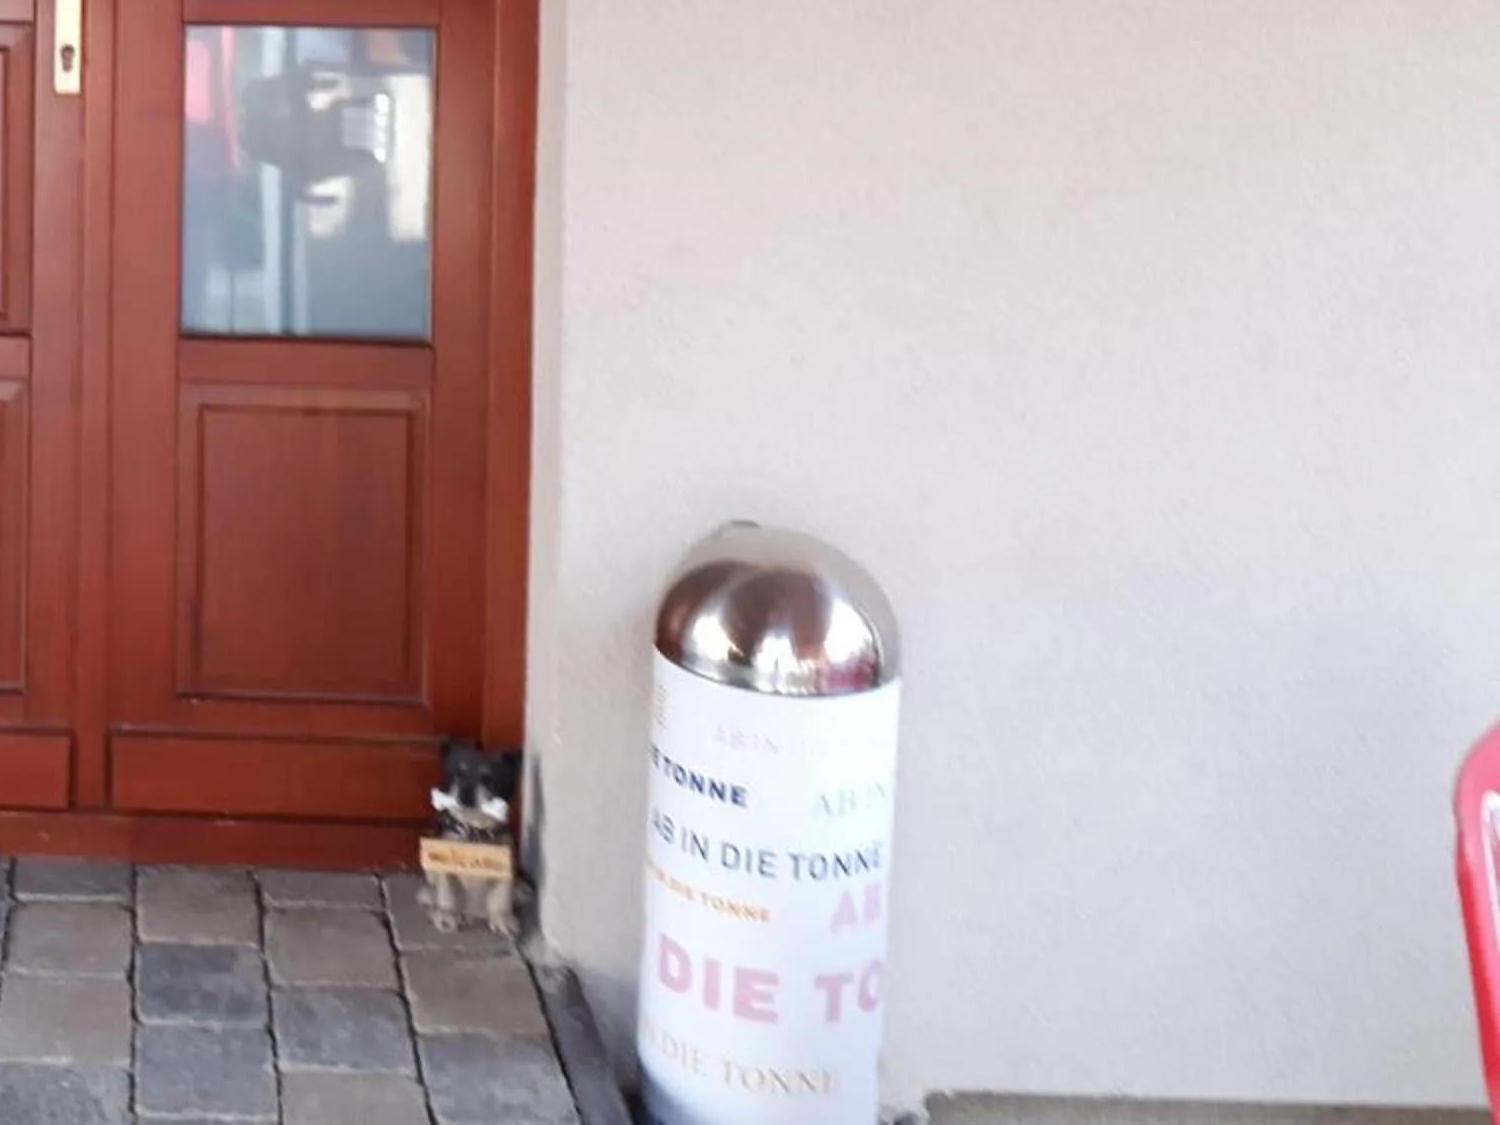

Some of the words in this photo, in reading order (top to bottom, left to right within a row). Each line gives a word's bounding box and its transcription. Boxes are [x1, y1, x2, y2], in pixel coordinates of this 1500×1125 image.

[662, 755, 748, 808] TONNE
[680, 826, 709, 862] IN
[720, 840, 777, 879] DIE
[700, 891, 771, 923] TONNE
[657, 931, 780, 1025] DIE
[662, 1030, 710, 1077] DIE
[719, 1056, 836, 1096] TONNE
